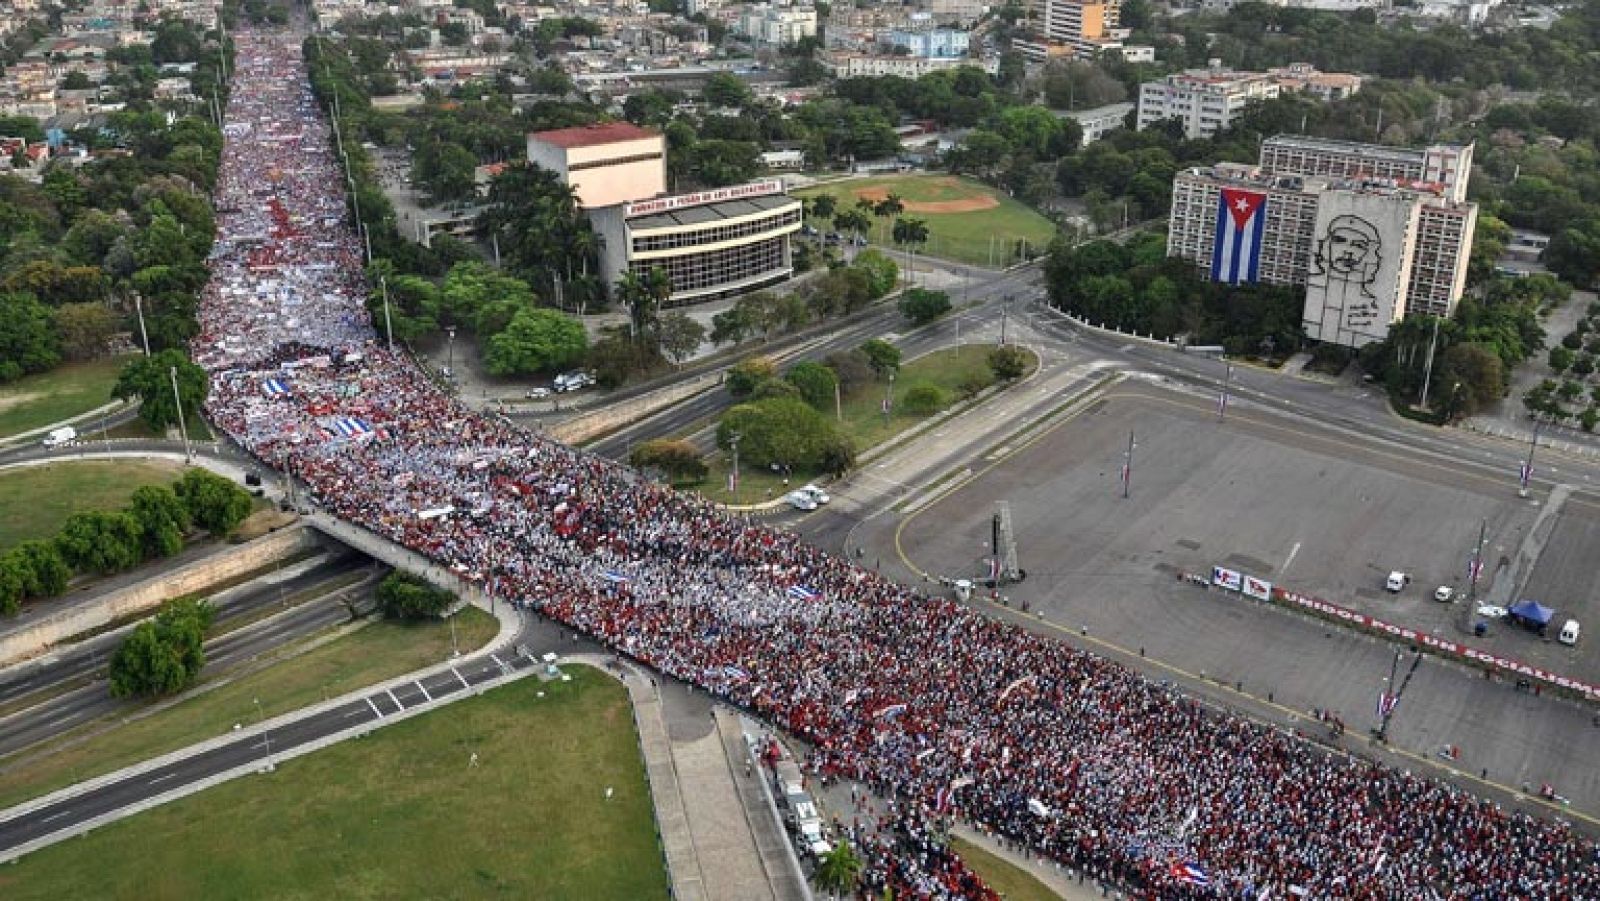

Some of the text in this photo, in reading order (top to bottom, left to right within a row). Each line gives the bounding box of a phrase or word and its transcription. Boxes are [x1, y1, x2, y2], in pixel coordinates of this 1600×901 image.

[1284, 591, 1364, 623] UNIDOS
[1371, 618, 1417, 638] POR
[1424, 635, 1456, 652] UN
